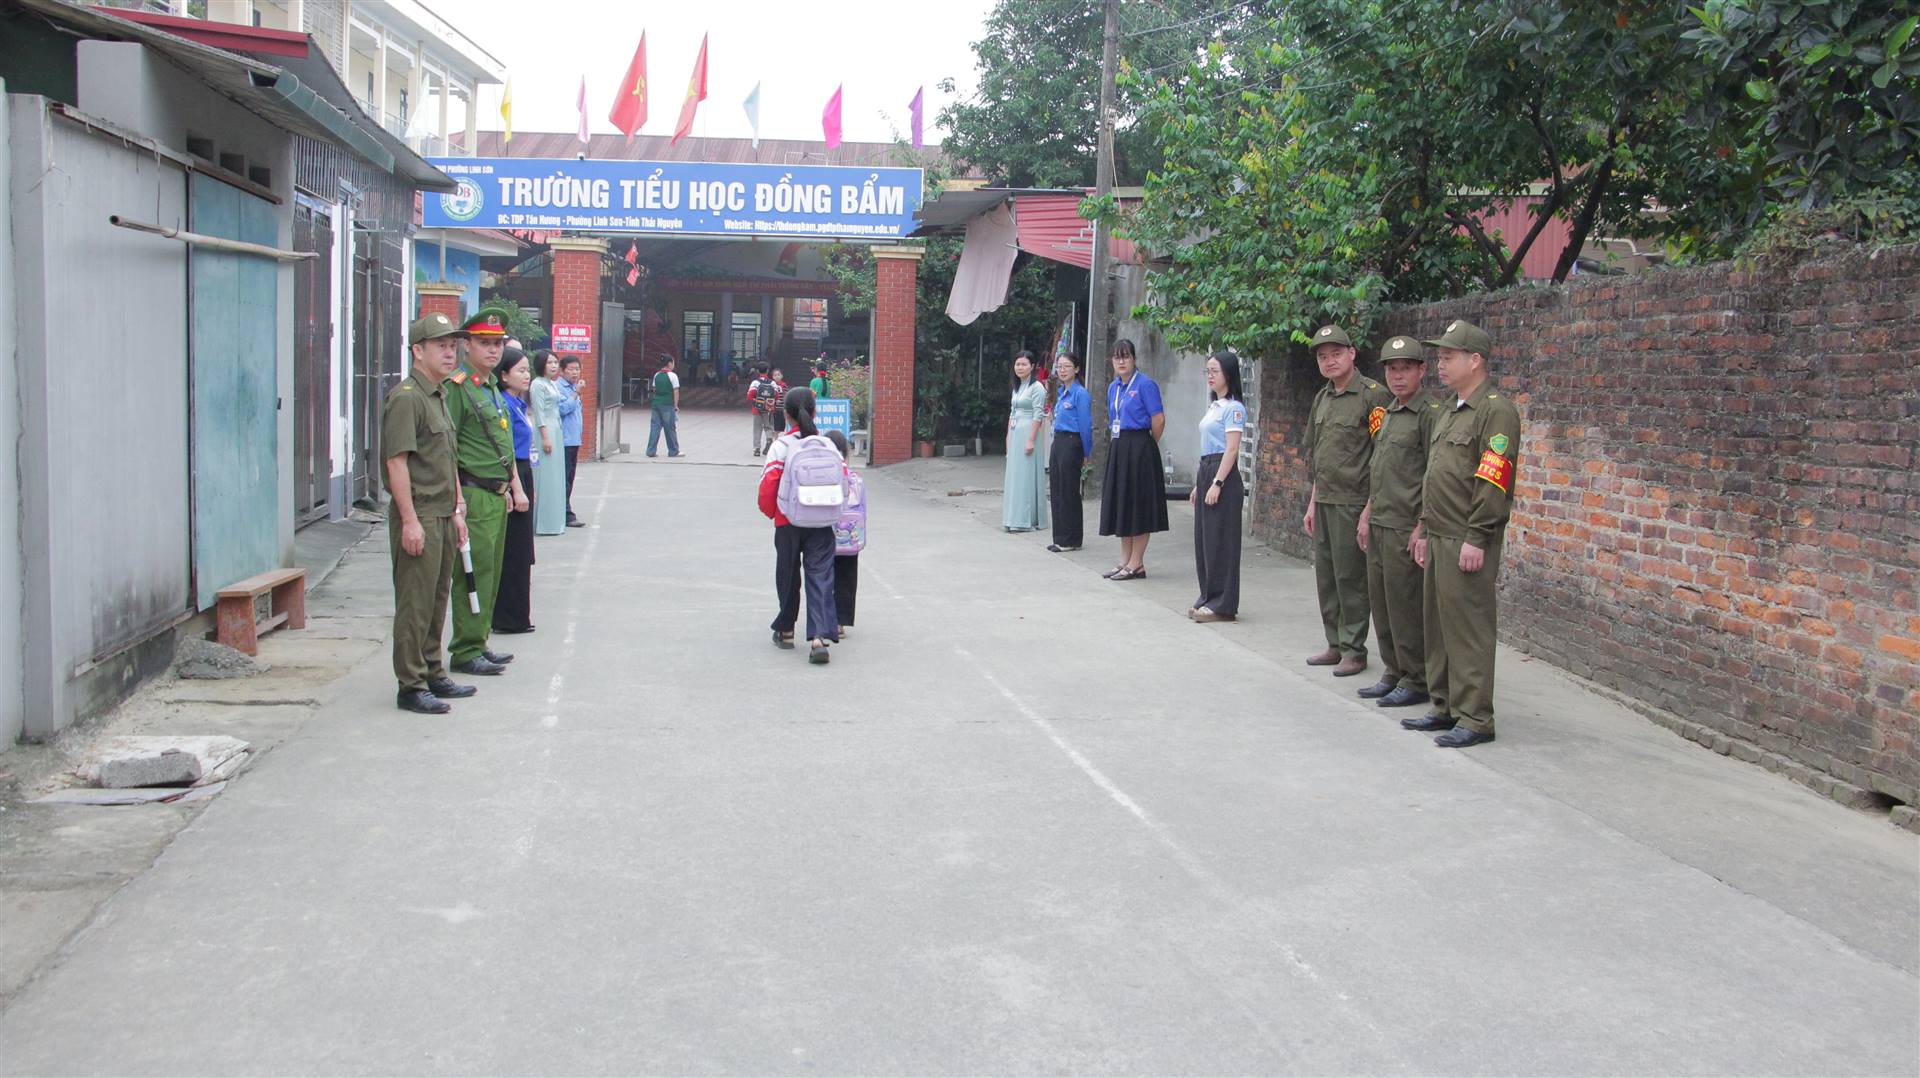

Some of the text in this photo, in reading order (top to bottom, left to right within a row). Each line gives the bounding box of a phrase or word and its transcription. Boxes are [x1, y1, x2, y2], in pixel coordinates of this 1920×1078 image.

[498, 168, 905, 216] TRƯỜNG TIỂU HỌC ĐỒNG BẨM
